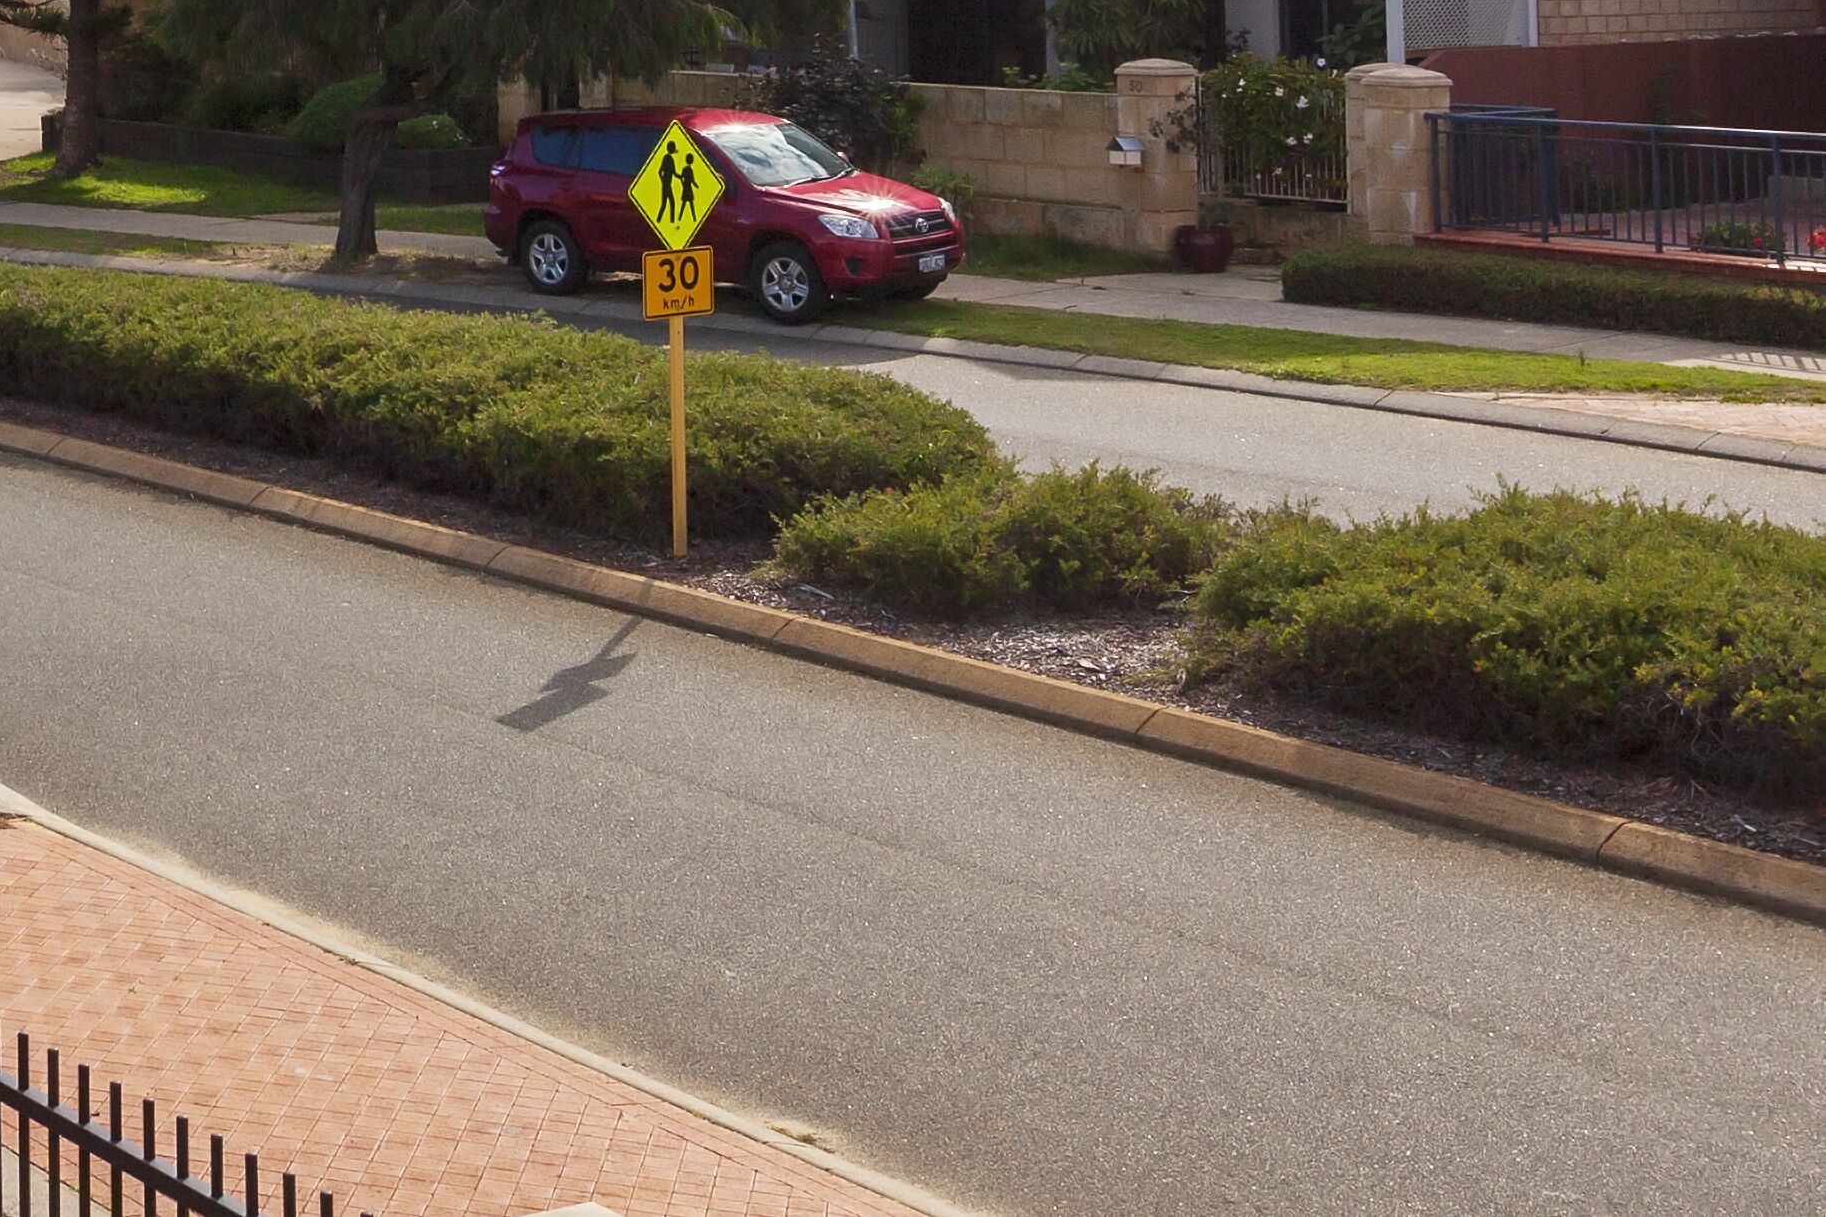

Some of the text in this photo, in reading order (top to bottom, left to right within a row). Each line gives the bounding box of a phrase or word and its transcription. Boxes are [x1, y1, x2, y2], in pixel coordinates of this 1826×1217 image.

[1129, 80, 1142, 93] 50
[658, 256, 699, 292] 30
[663, 295, 694, 310] km/h
